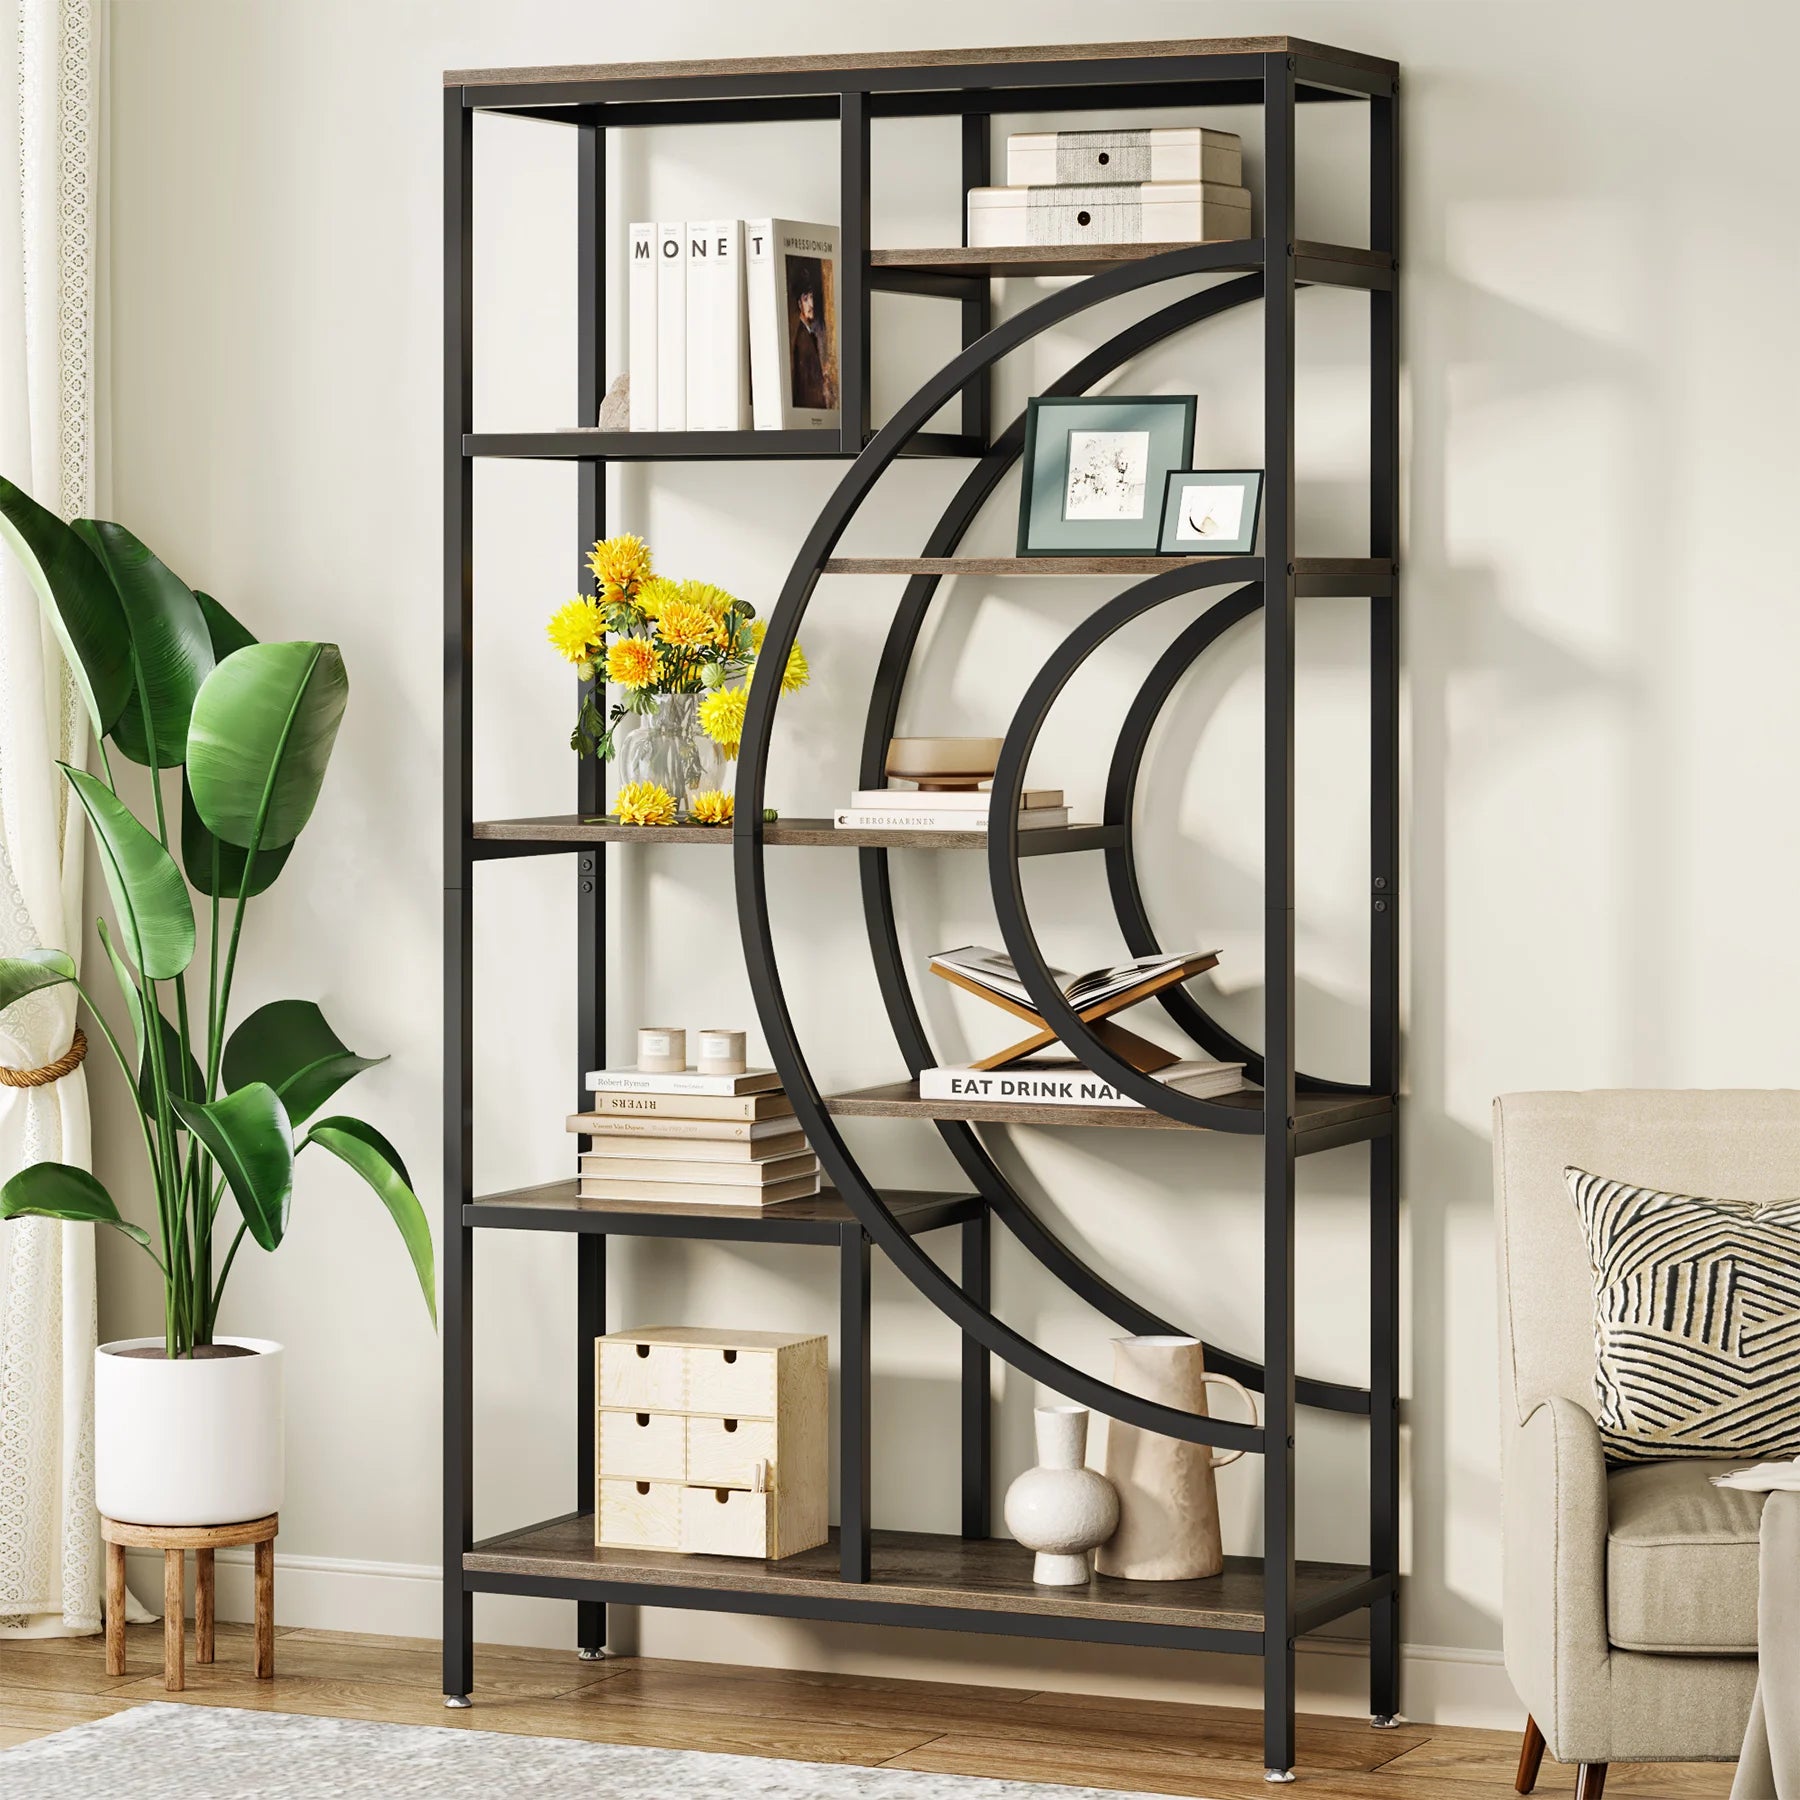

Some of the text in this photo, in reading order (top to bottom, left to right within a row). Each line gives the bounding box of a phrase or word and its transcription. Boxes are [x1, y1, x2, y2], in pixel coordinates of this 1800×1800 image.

[783, 237, 833, 253] IMPRESSIONISM
[859, 817, 935, 826] EERO SAARINEN
[598, 1078, 650, 1089] Robert Ryman
[951, 1078, 993, 1095] EAT
[1001, 1080, 1073, 1098] DRINK
[611, 1099, 657, 1110] RIVERS
